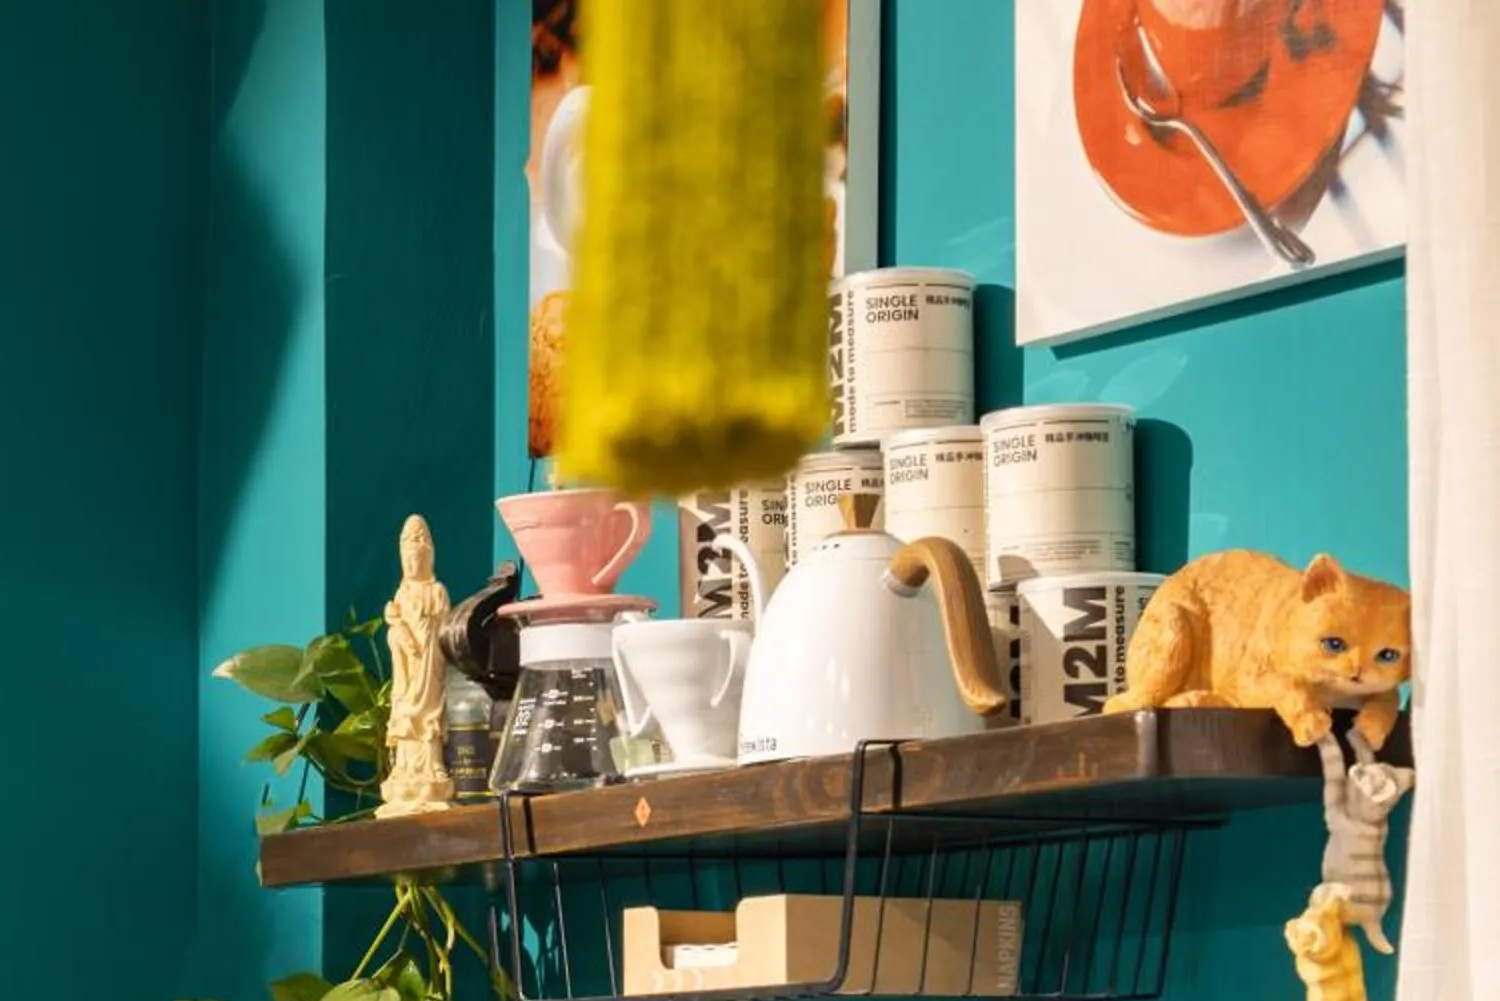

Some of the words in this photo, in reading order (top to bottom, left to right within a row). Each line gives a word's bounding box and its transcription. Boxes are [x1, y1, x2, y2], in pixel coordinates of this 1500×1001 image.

[866, 294, 918, 309] SINGLE
[866, 308, 920, 323] ORIGIN
[846, 290, 855, 363] measure
[847, 366, 855, 383] to
[847, 386, 857, 433] made
[993, 434, 1037, 452] SINGLE
[889, 453, 928, 470] SINGLE
[993, 450, 1038, 467] ORIGIN
[889, 467, 929, 485] ORIGIN
[804, 478, 853, 495] SINGLE
[804, 493, 838, 508] ORIG
[738, 487, 750, 543] easure
[1114, 585, 1126, 666] measure
[1063, 586, 1108, 718] M2M
[1114, 667, 1126, 684] to
